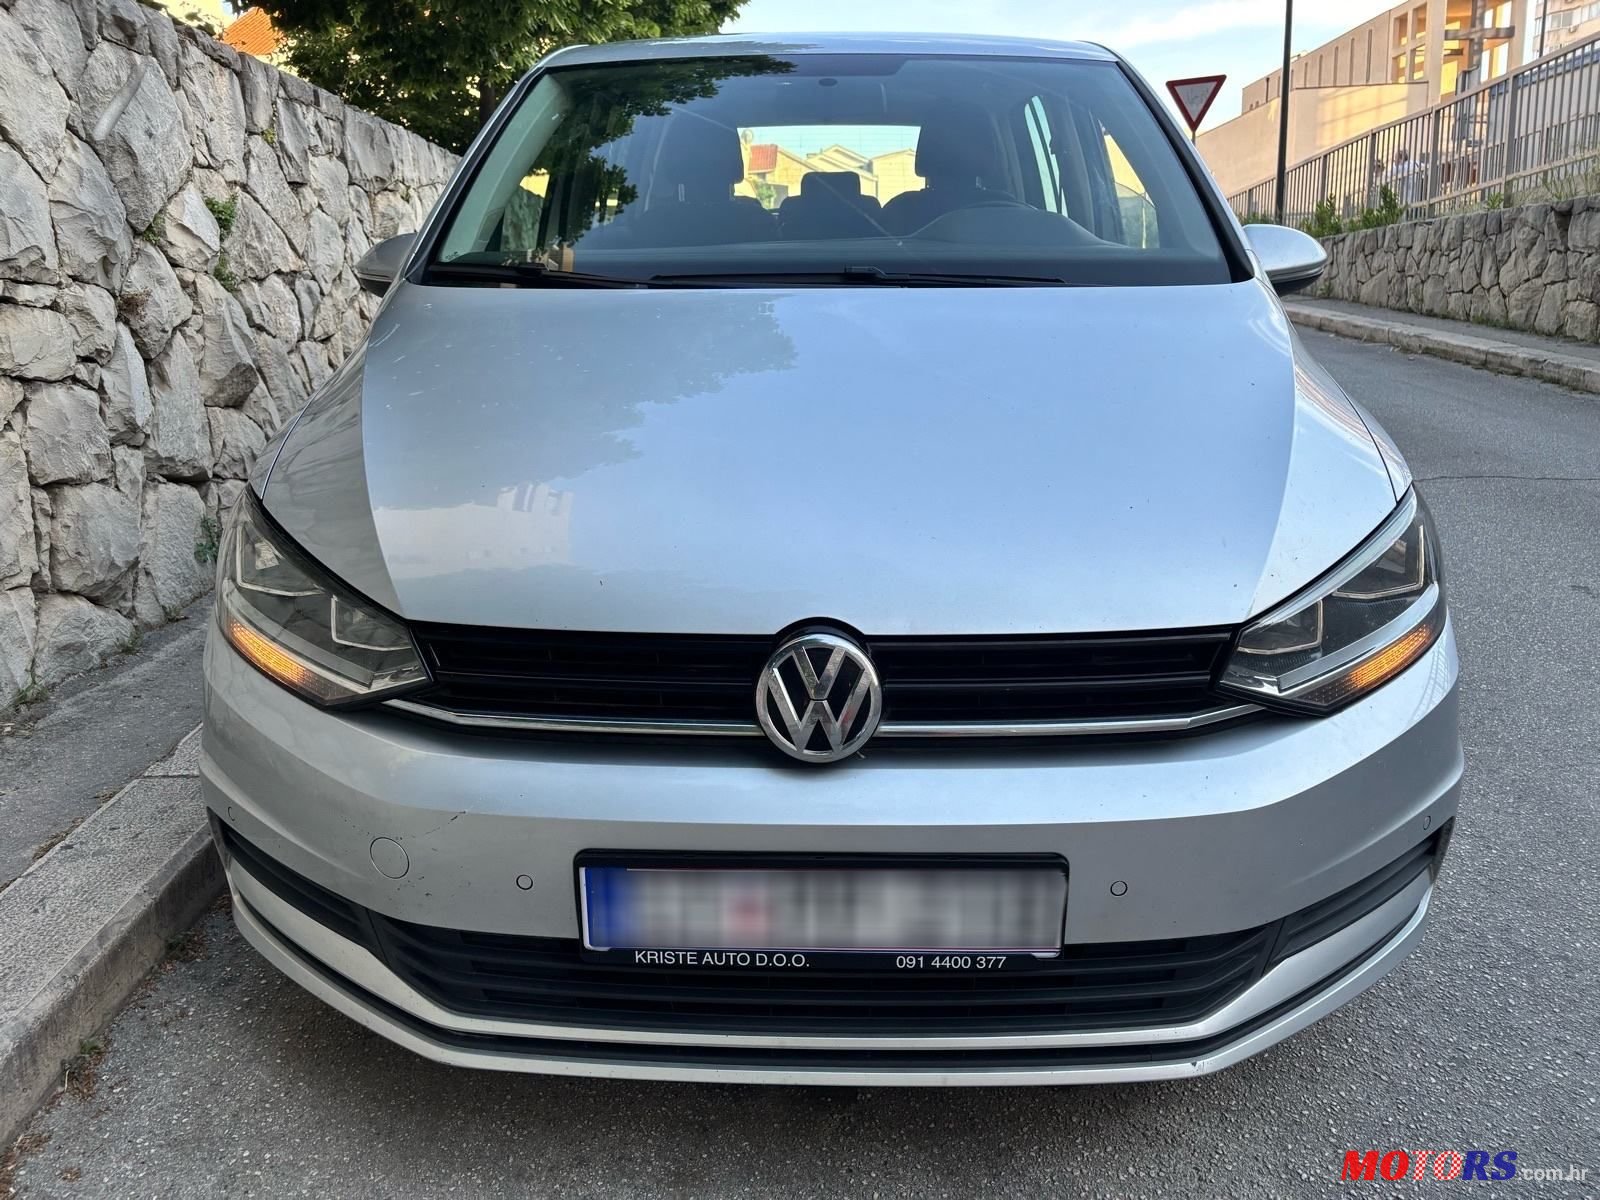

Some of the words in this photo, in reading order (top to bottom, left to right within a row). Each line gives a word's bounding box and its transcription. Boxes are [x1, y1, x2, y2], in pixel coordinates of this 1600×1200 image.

[635, 950, 698, 965] KRISTE
[702, 952, 751, 966] AUTO
[755, 953, 810, 967] D.O.O.
[896, 955, 924, 969] 091
[931, 956, 971, 969] 4400
[976, 956, 1007, 969] 377
